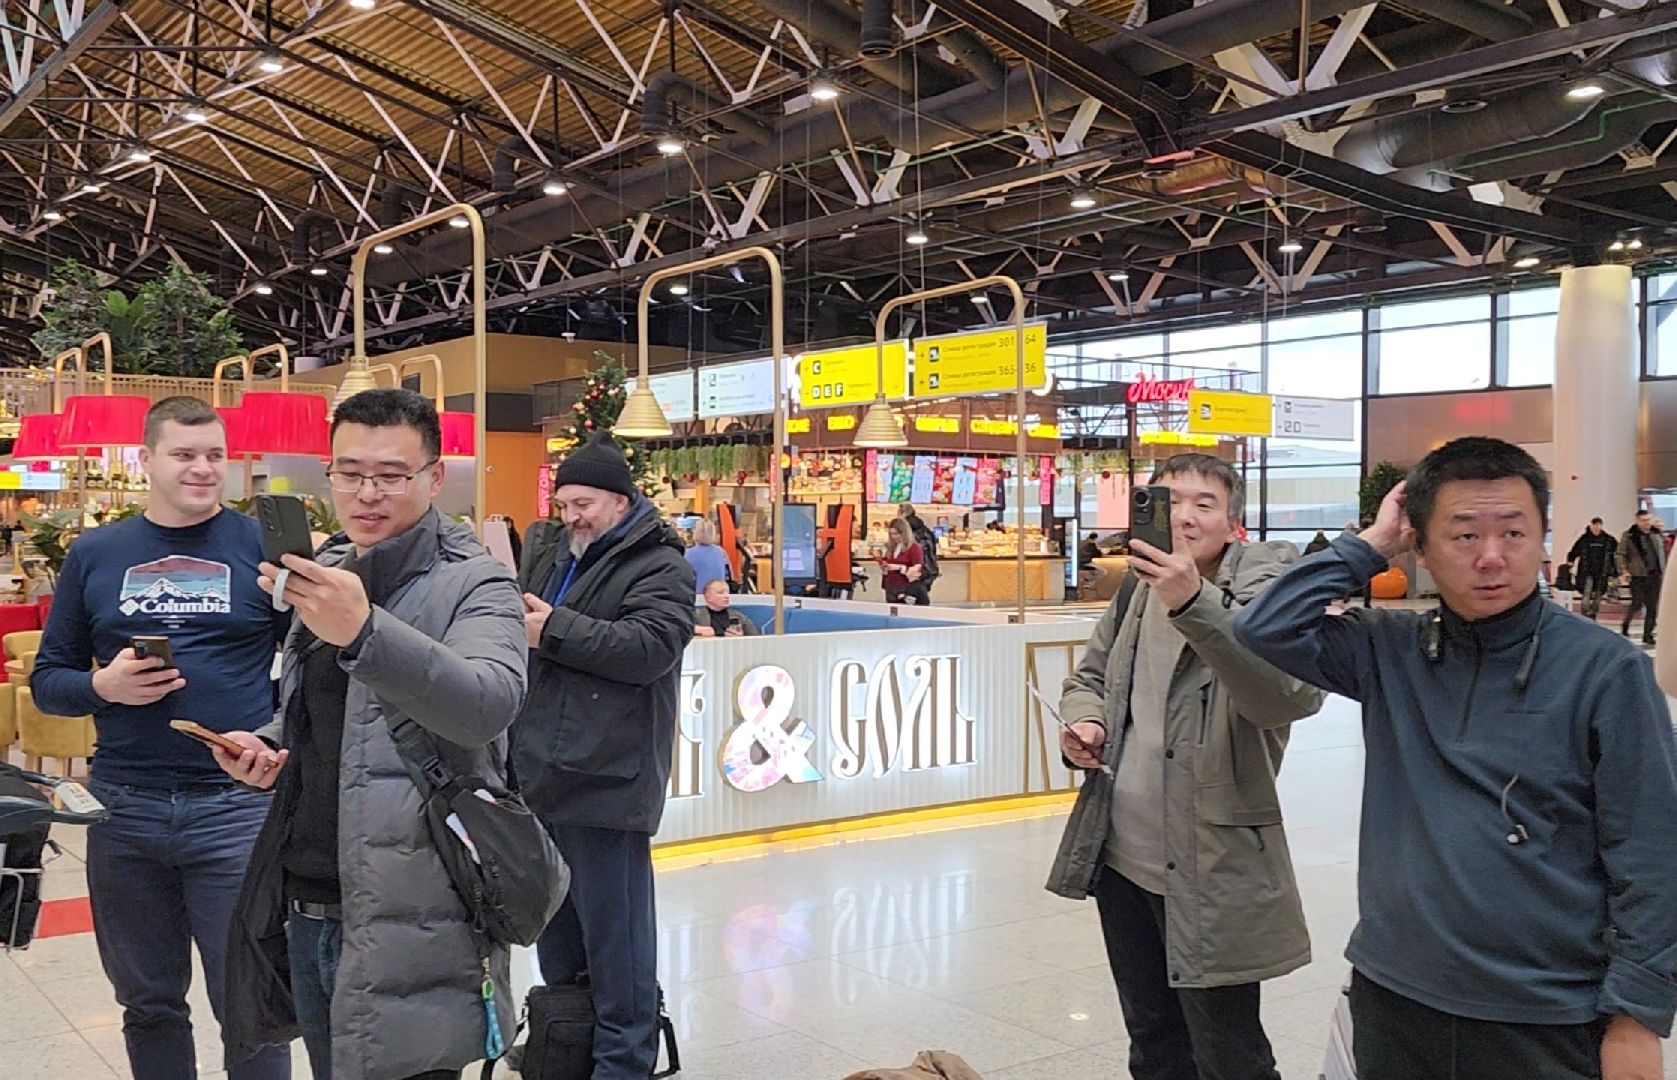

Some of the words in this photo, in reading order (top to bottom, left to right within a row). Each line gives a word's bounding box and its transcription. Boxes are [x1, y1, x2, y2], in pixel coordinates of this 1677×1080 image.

[998, 336, 1015, 347] 301
[998, 364, 1015, 375] 365
[1284, 420, 1301, 433] 20
[140, 599, 231, 613] Columbia
[720, 664, 825, 792] &
[830, 653, 977, 780] СОЛЬ
